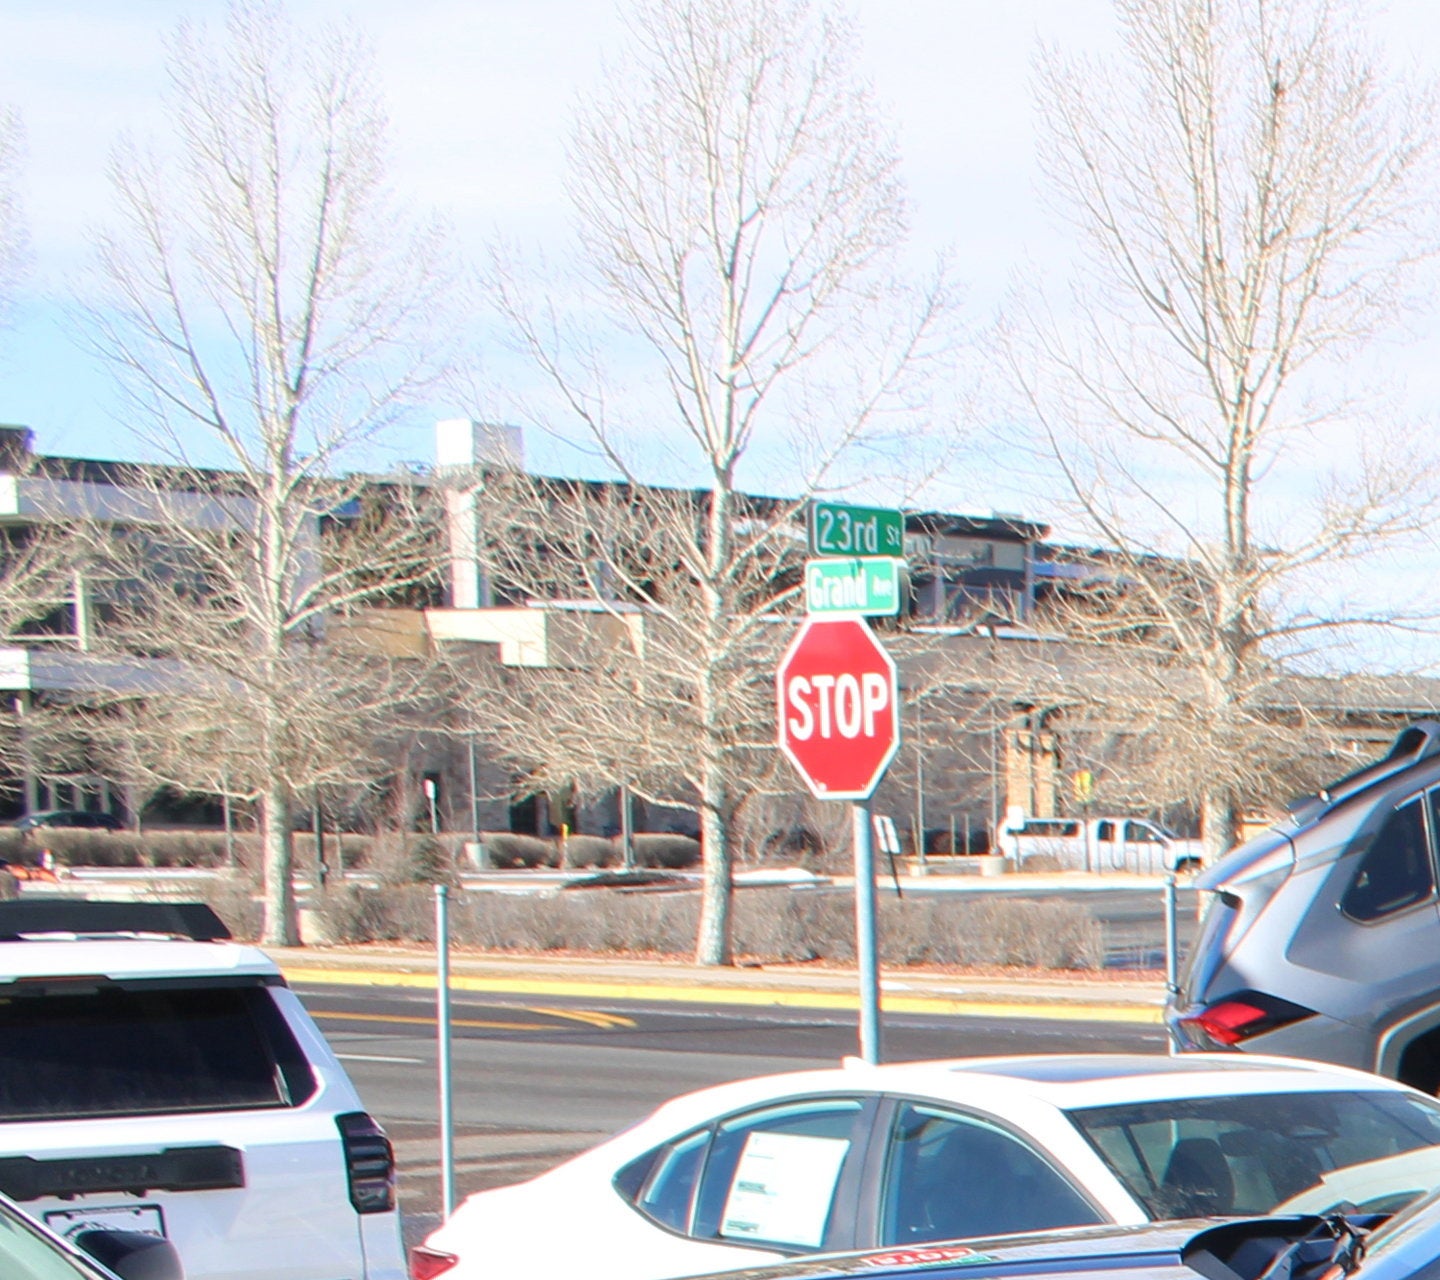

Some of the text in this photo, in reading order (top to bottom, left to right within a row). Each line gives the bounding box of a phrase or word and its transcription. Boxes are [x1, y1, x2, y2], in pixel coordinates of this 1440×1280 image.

[819, 509, 879, 553] 23rd
[810, 566, 868, 609] Grand
[788, 672, 888, 741] STOP
